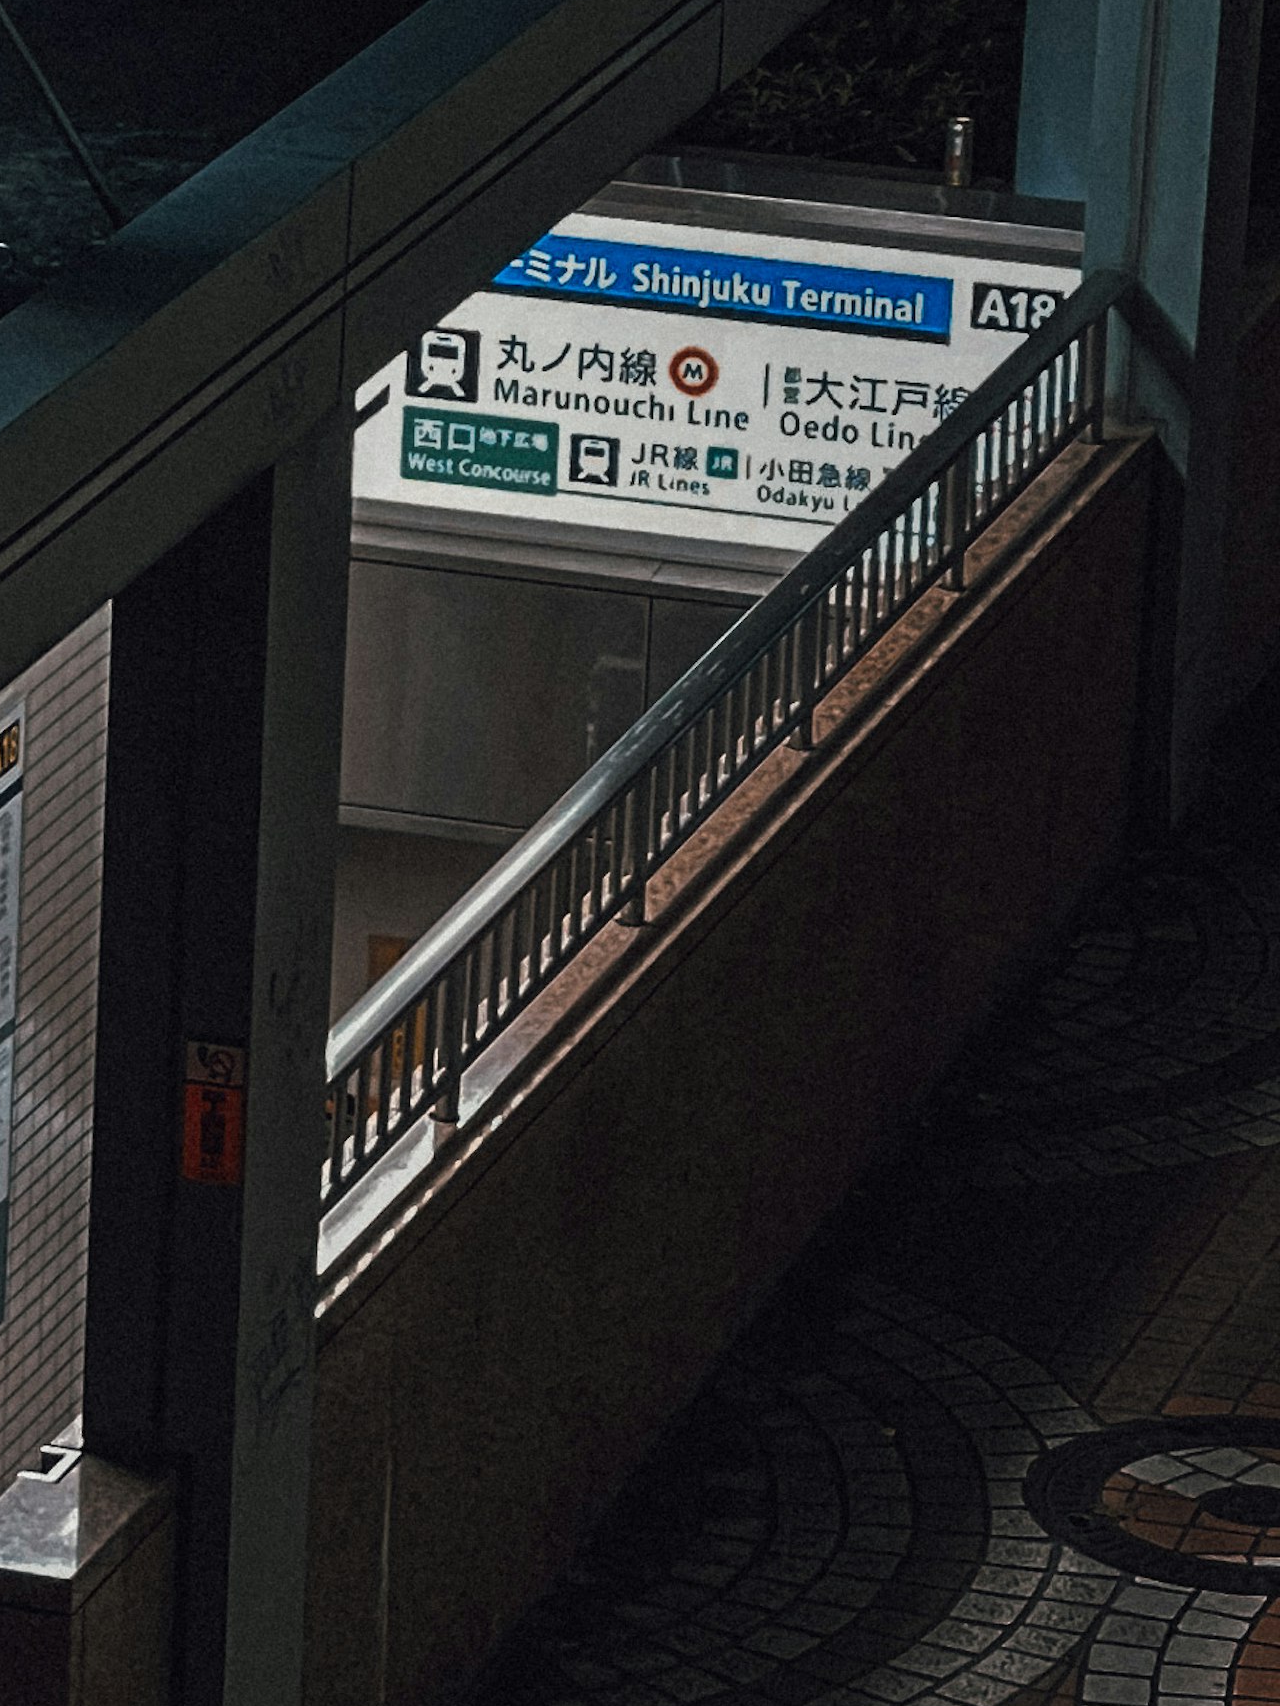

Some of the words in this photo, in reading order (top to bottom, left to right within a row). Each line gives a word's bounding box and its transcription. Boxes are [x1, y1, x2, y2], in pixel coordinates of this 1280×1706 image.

[631, 262, 771, 308] Shinjuku
[781, 279, 925, 325] Terminal
[976, 288, 1056, 330] A18
[496, 334, 658, 387] 丸ノ内線
[494, 377, 675, 422] Marunouchi
[687, 400, 750, 431] Line
[779, 410, 859, 445] Oedo
[871, 421, 928, 451] Lin
[407, 451, 454, 475] West
[458, 455, 551, 487] Concourse
[630, 442, 699, 471] JR線
[759, 458, 871, 491] 小田急線
[629, 469, 650, 489] JR
[658, 471, 710, 496] Lines
[756, 484, 835, 513] Odakyu
